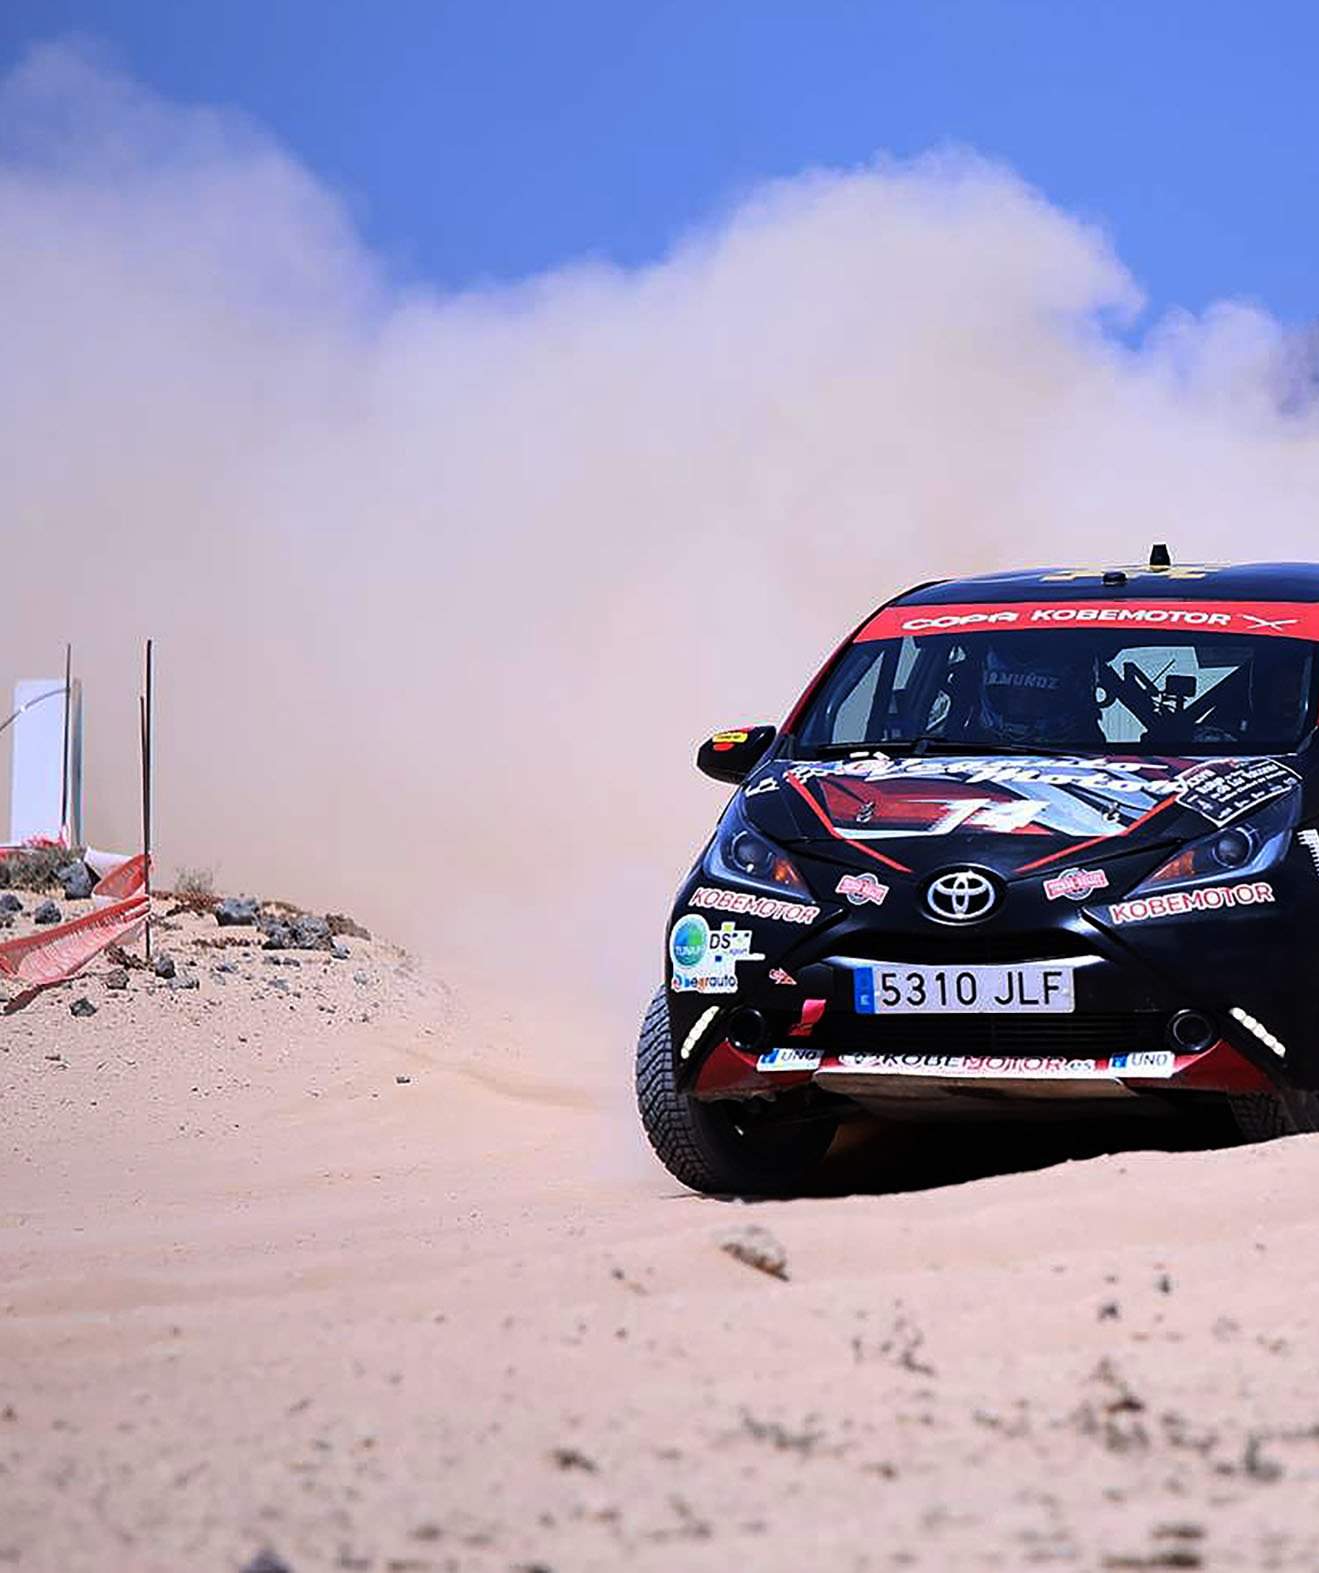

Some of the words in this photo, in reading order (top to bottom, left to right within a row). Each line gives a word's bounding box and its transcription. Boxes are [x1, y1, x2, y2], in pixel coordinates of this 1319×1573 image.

[902, 612, 1018, 631] COPA
[1031, 608, 1231, 627] KOBEMOTOR
[690, 888, 819, 923] KOBEMOTOR
[1111, 883, 1275, 924] KOBEMOTOR
[881, 971, 977, 1006] 5310
[994, 970, 1063, 1006] JLF
[1131, 1053, 1168, 1066] UNO
